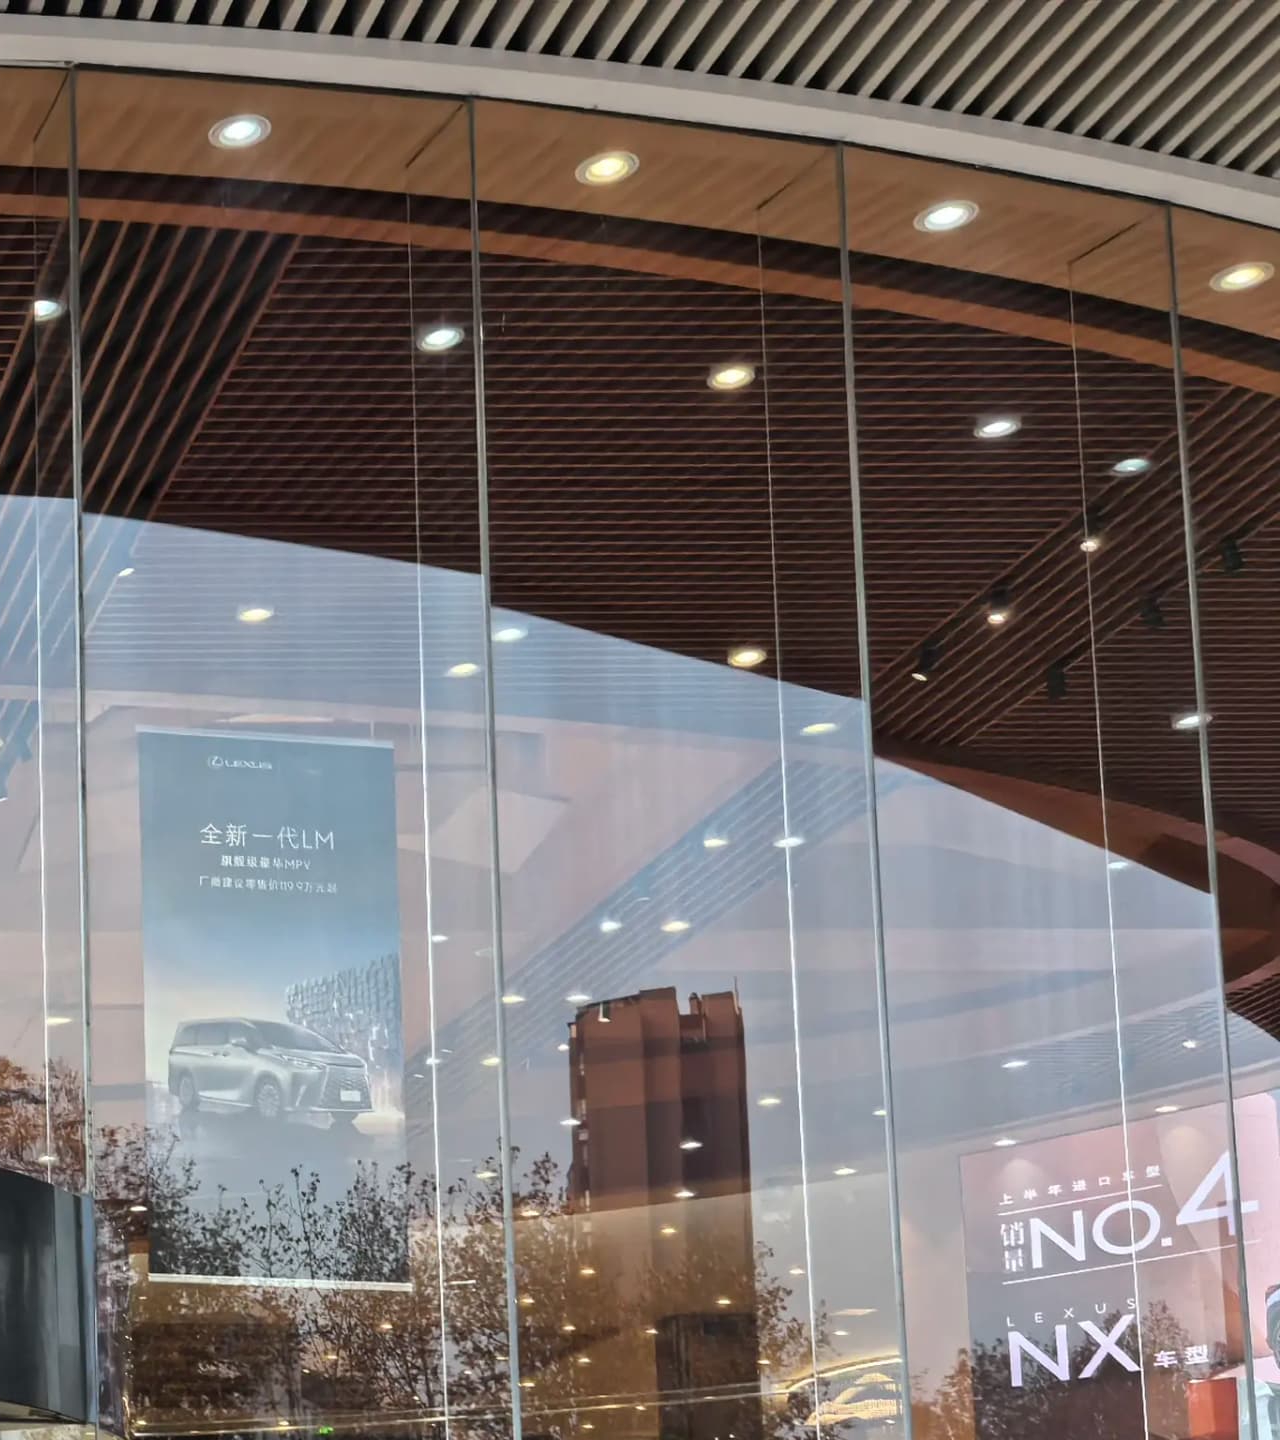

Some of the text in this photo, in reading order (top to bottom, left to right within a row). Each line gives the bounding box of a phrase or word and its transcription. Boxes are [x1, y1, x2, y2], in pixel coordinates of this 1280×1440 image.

[199, 823, 335, 850] 全新一代LM
[998, 1165, 1162, 1206] 上半年进口车型
[1000, 1222, 1026, 1272] 销量
[1006, 1297, 1137, 1328] LEXUS
[1007, 1313, 1209, 1388] NX 车型
